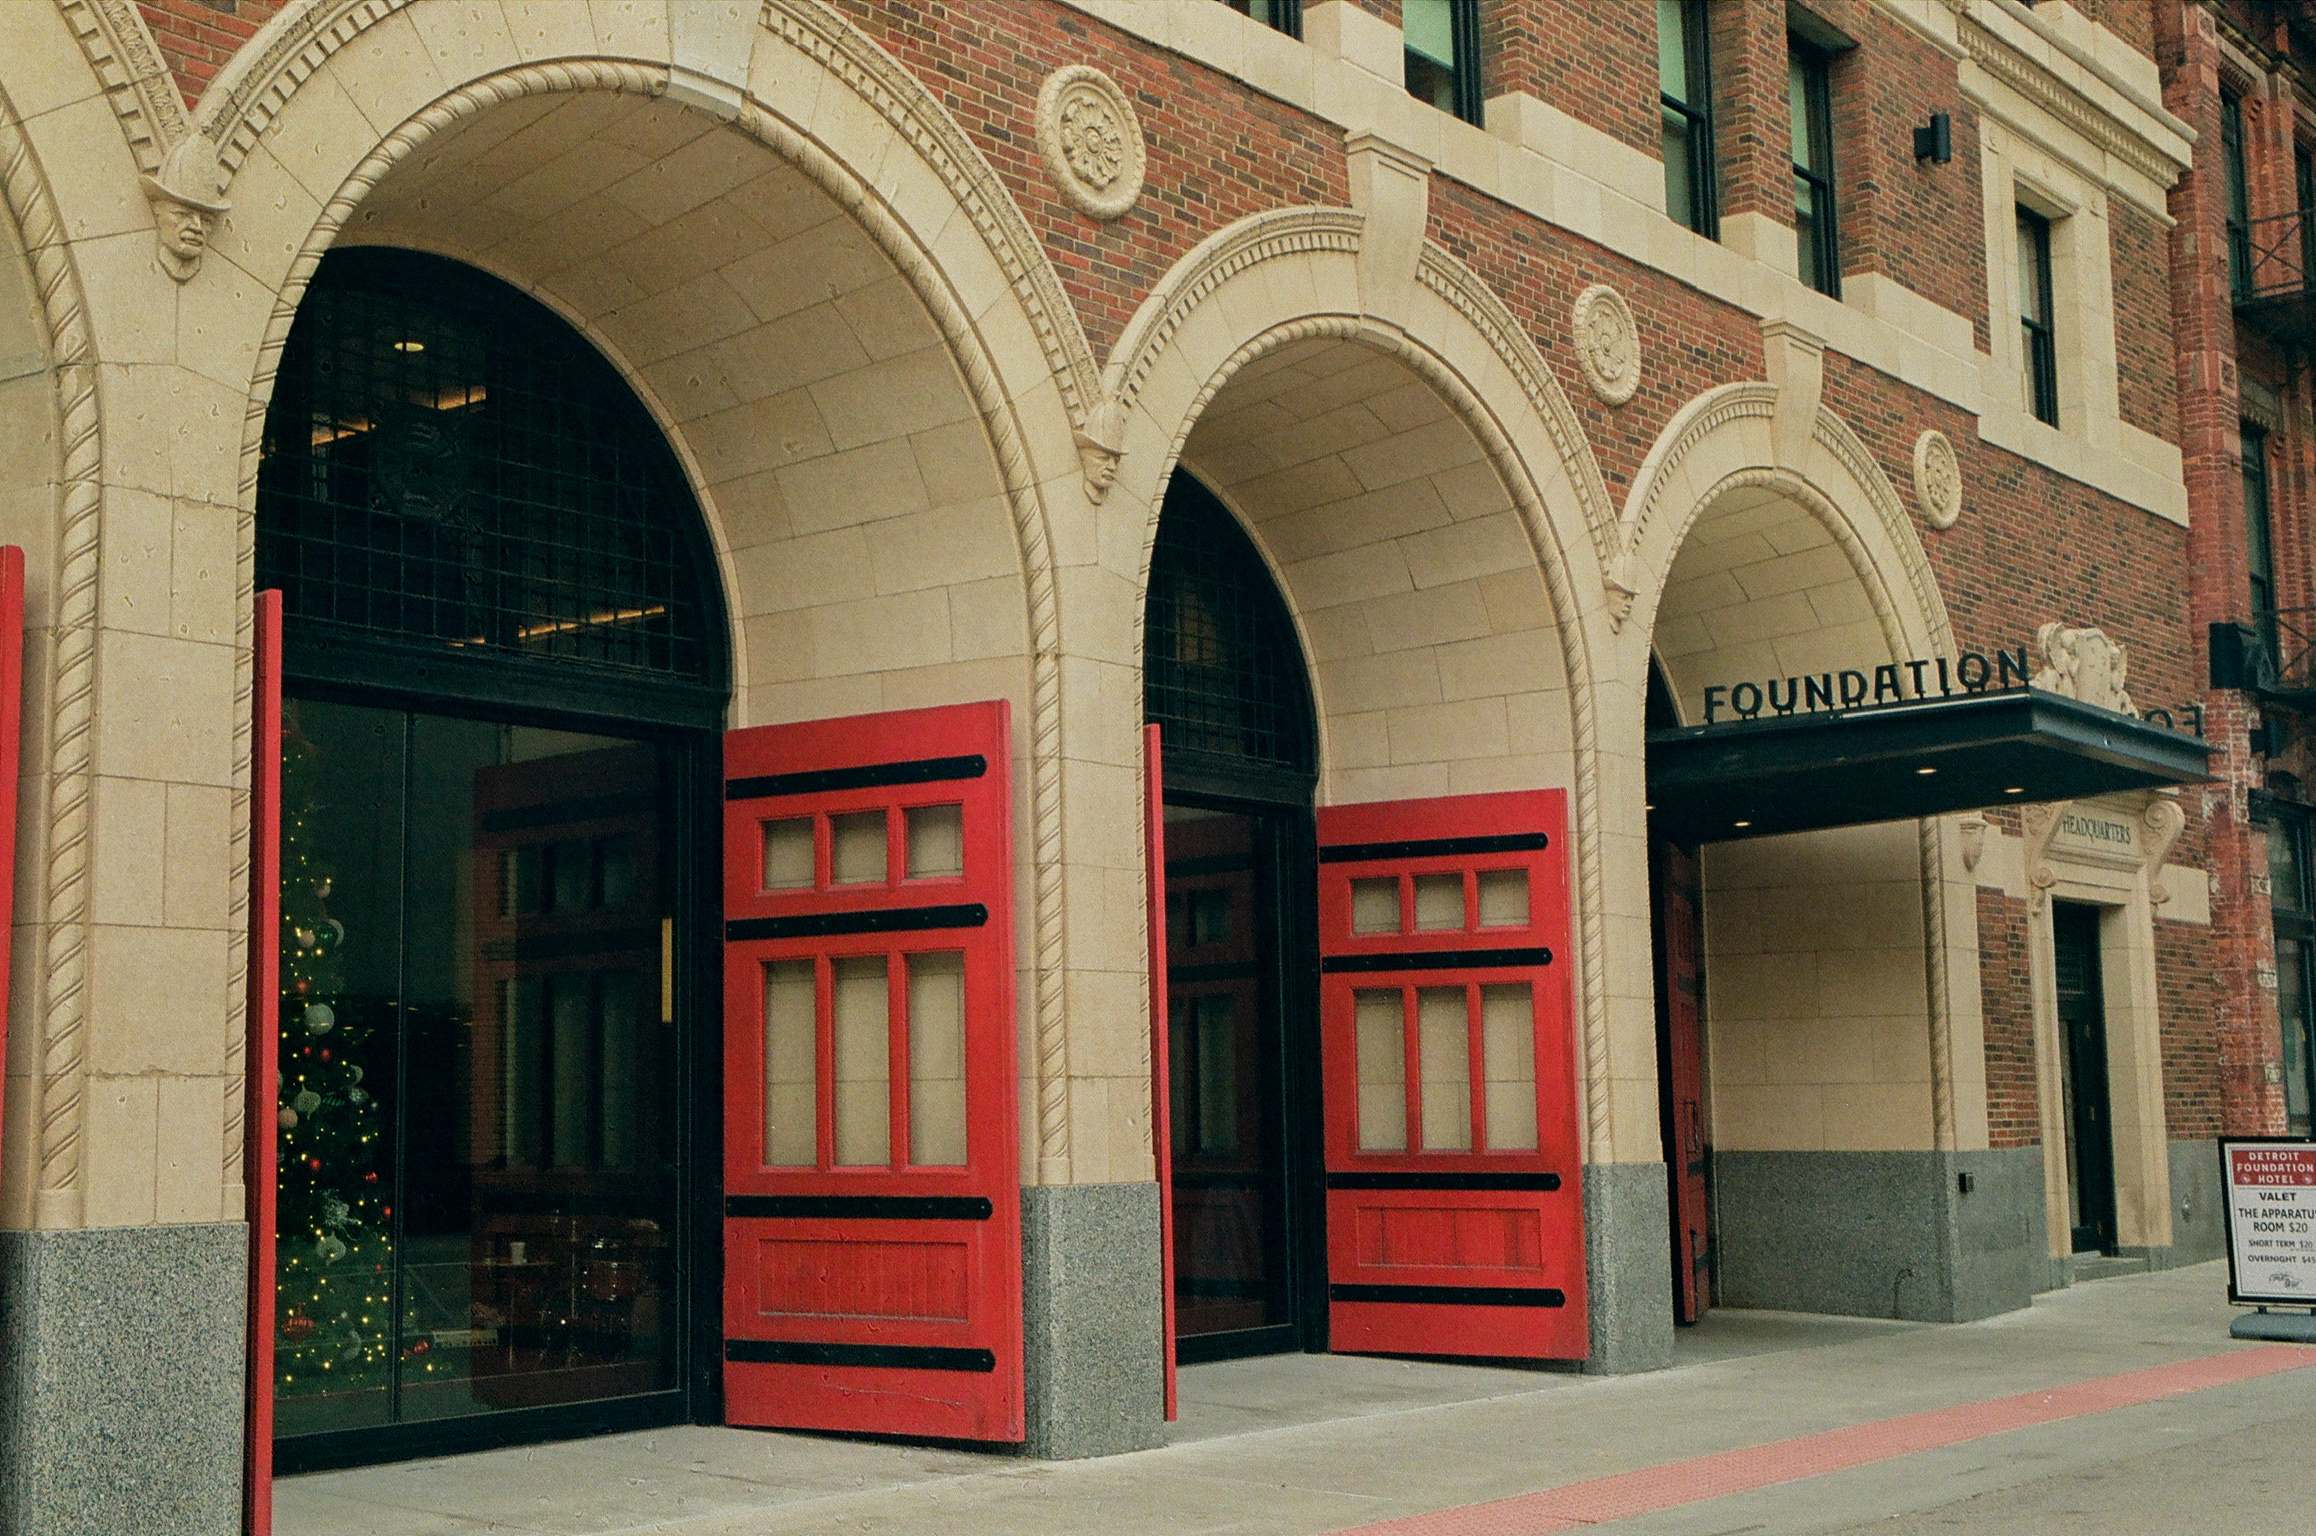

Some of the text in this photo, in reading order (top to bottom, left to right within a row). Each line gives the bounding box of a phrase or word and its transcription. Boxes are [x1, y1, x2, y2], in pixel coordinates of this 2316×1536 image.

[1703, 647, 2029, 720] FOUNDATION
[2063, 815, 2131, 844] HEADQUARTERS
[2249, 1152, 2299, 1161] DETROIT
[2237, 1163, 2314, 1172] FOUNDATION
[2258, 1175, 2295, 1184] HOTEL
[2259, 1192, 2297, 1201] VALET
[2238, 1208, 2316, 1219] THE APPARATU
[2253, 1222, 2308, 1233] ROOM $20
[2276, 1240, 2295, 1248] TERM
[2248, 1255, 2296, 1263] OVERNIGHT
